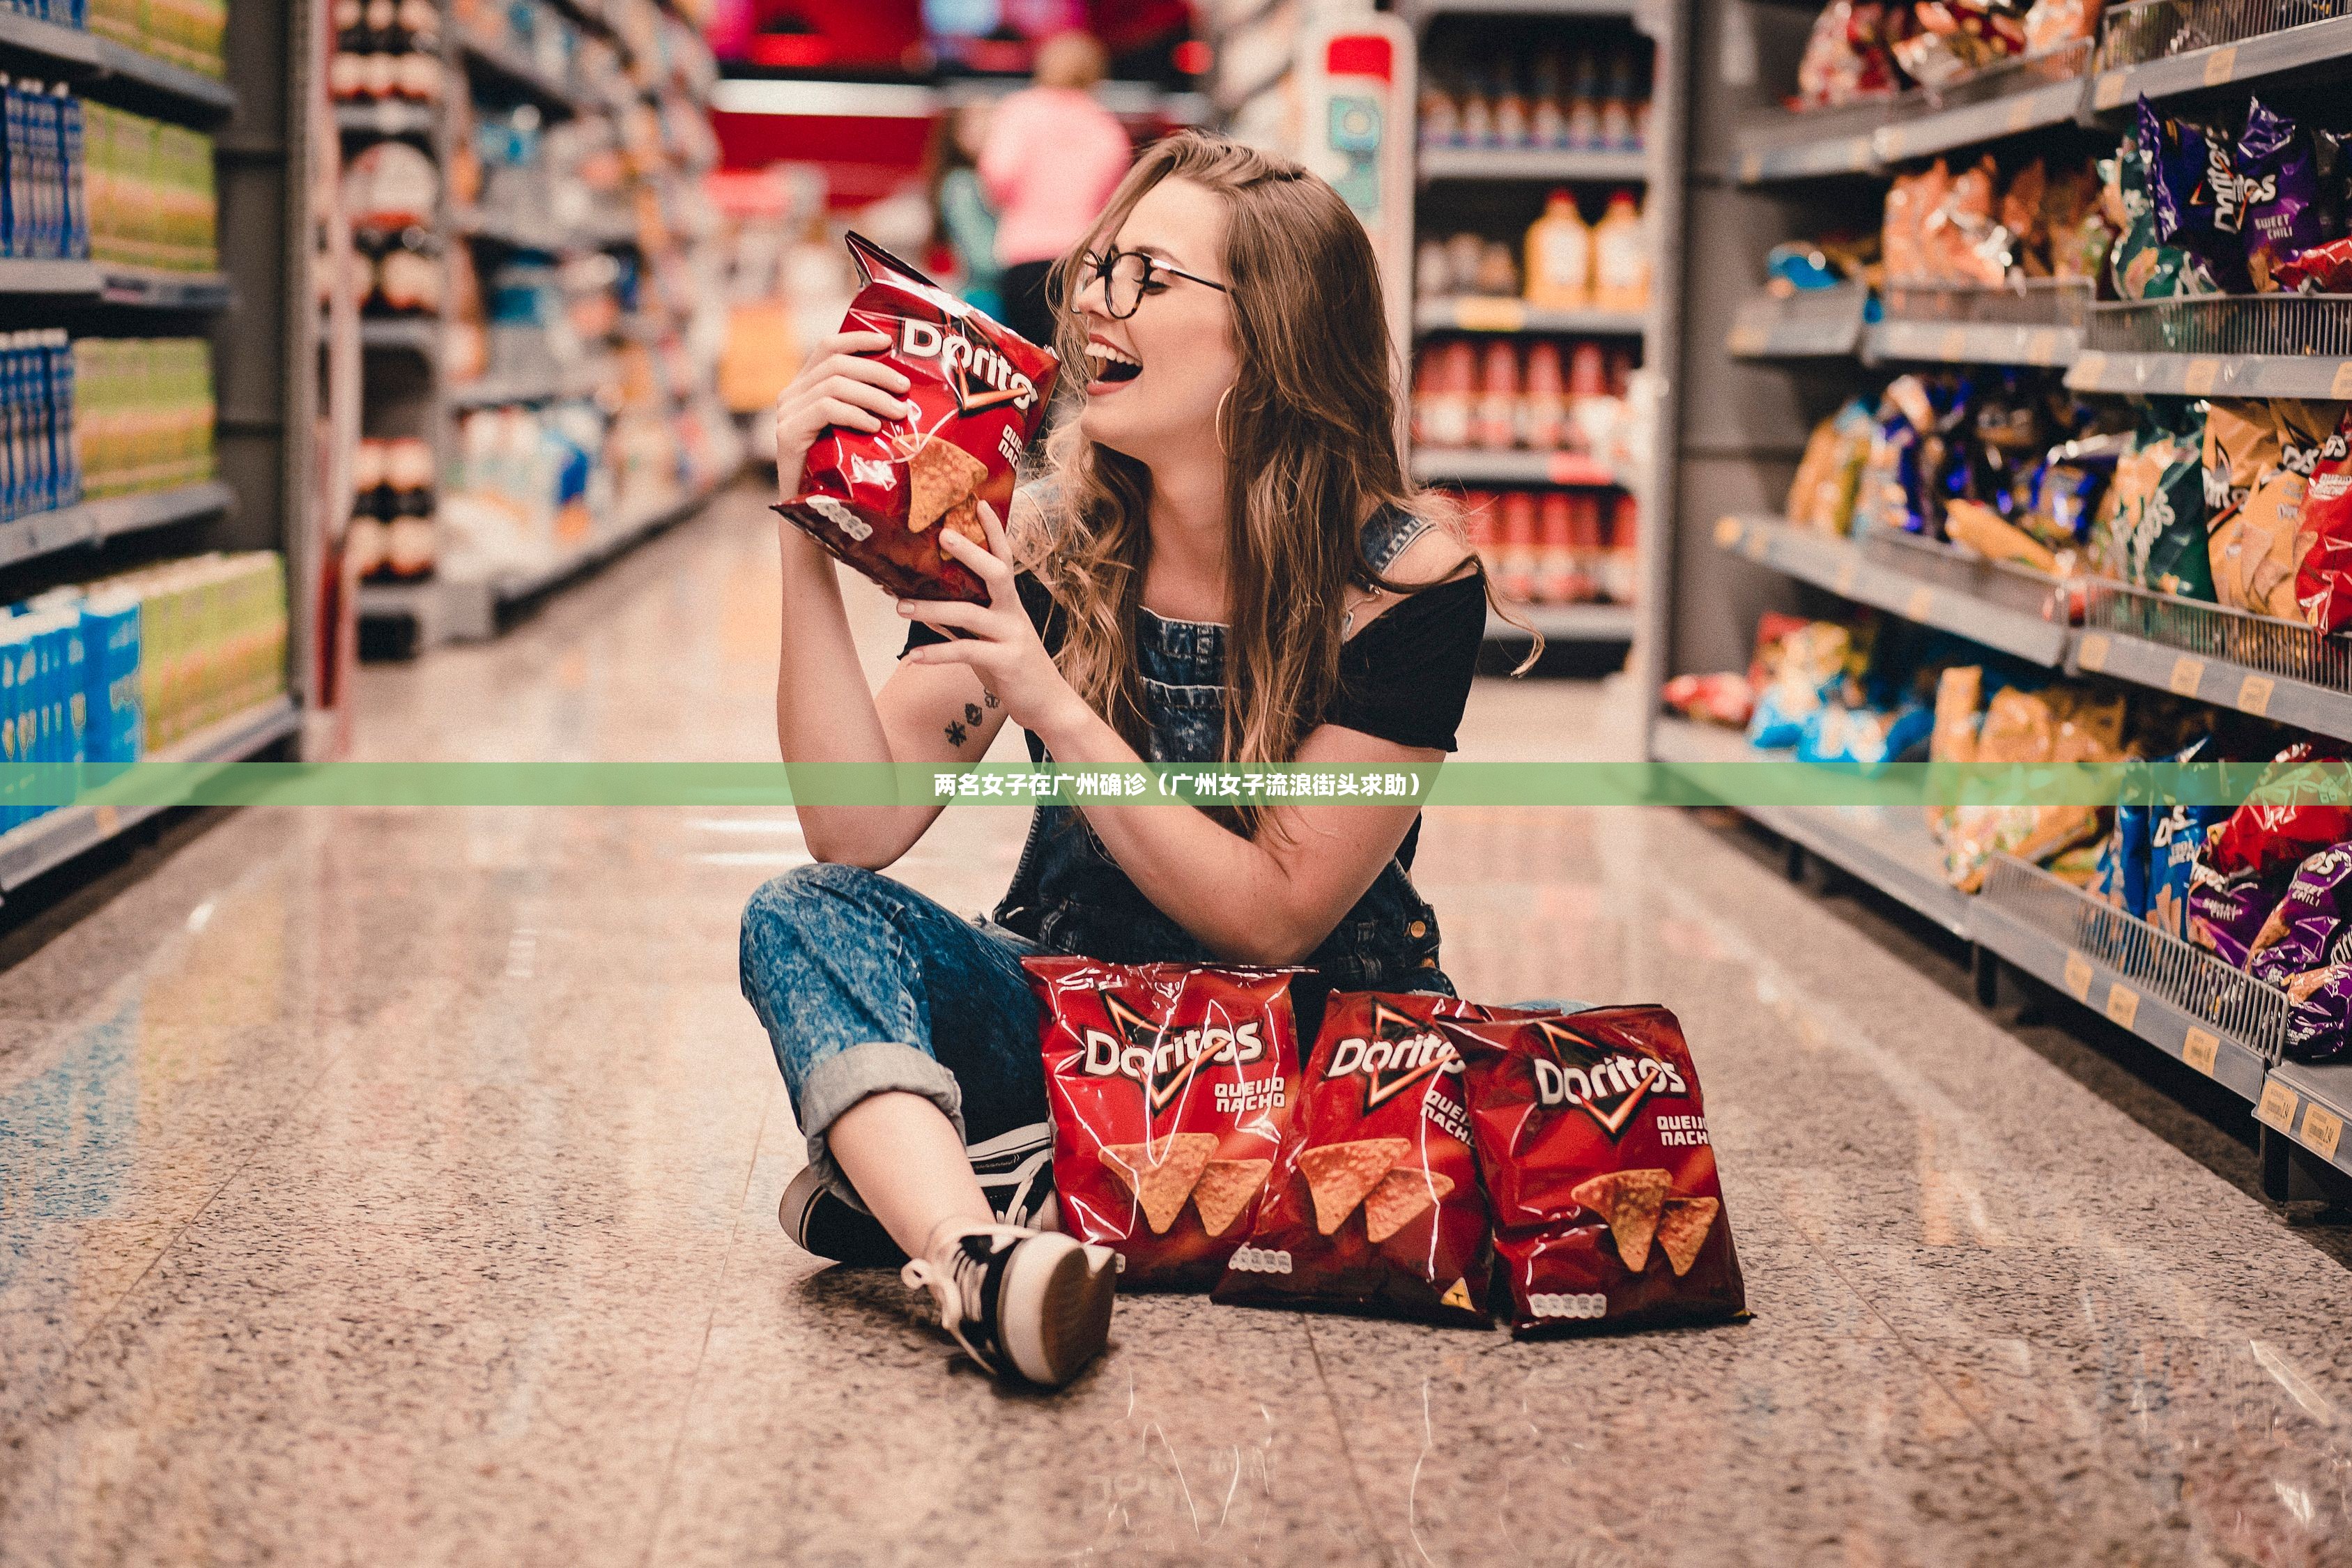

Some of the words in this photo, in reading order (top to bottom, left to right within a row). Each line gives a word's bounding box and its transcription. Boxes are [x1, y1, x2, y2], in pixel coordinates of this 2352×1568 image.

[1084, 1022, 1263, 1077] Doritos
[1327, 1033, 1466, 1078] Dorito
[1215, 1077, 1284, 1097] QUEIJO
[1534, 1056, 1686, 1105] Doritos
[1216, 1093, 1285, 1113] NACHO
[1657, 1116, 1706, 1130] QUEIJ
[1661, 1130, 1709, 1146] NACH
